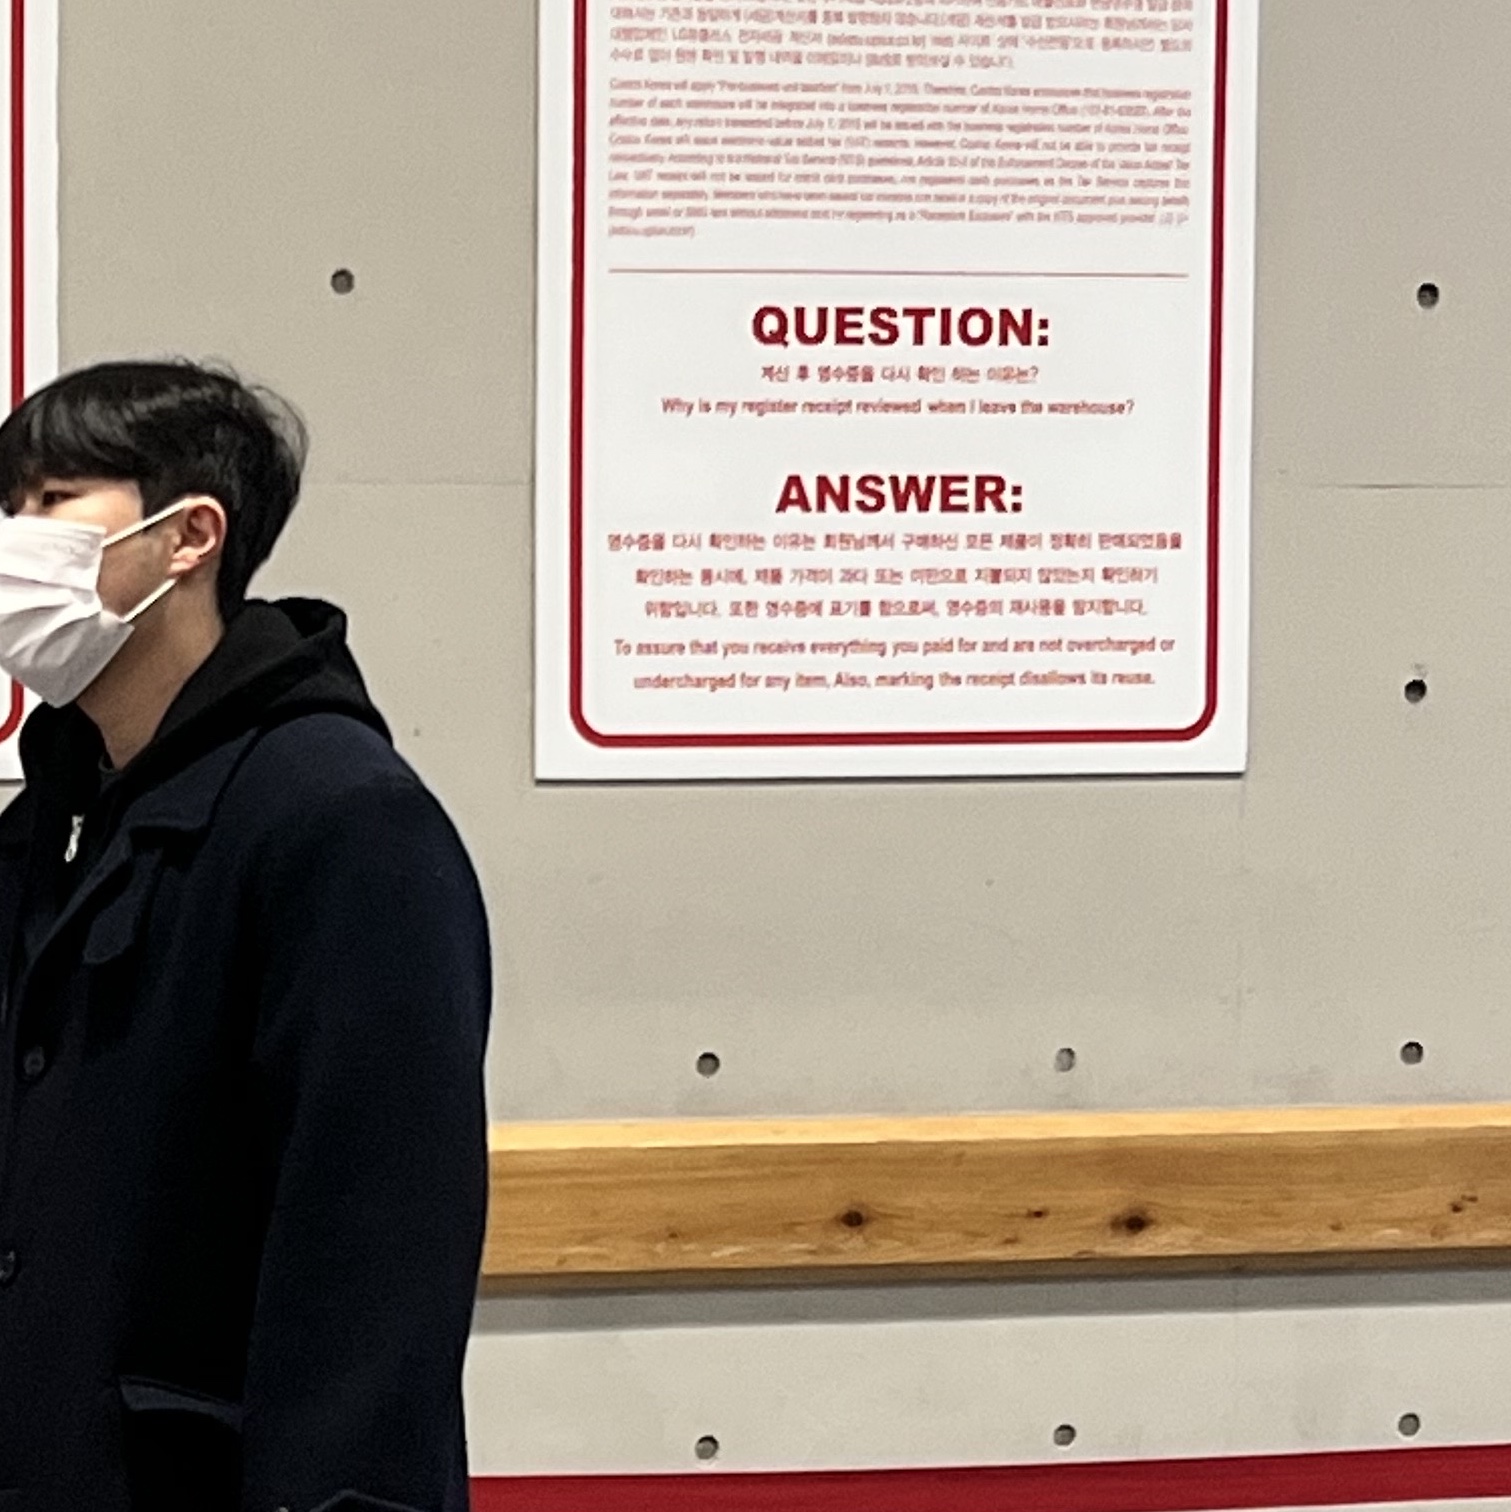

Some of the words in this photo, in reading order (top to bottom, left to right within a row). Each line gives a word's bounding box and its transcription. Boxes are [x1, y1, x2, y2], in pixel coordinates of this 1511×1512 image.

[751, 305, 1050, 350] QUESTION:
[660, 397, 695, 418] Why
[698, 397, 712, 414] is
[714, 400, 739, 418] my
[741, 397, 799, 418] register
[801, 398, 853, 417] receipt
[855, 397, 922, 415] reviewed
[926, 398, 967, 415] when
[969, 398, 976, 414] I
[978, 398, 1017, 415] leave
[1020, 399, 1044, 416] the
[1047, 398, 1136, 416] warehouse?
[774, 473, 1023, 514] ANSWER:
[613, 638, 632, 657] To
[636, 642, 686, 657] assure
[689, 639, 718, 656] that
[722, 641, 749, 660] you
[753, 639, 807, 655] receive
[810, 638, 887, 659] everything
[892, 640, 919, 658] you
[922, 636, 954, 657] paid
[957, 636, 978, 654] for
[982, 636, 1009, 653] and
[1012, 639, 1035, 654] are
[1039, 637, 1063, 653] not
[1067, 635, 1156, 657] overcharged
[1160, 638, 1176, 653] or
